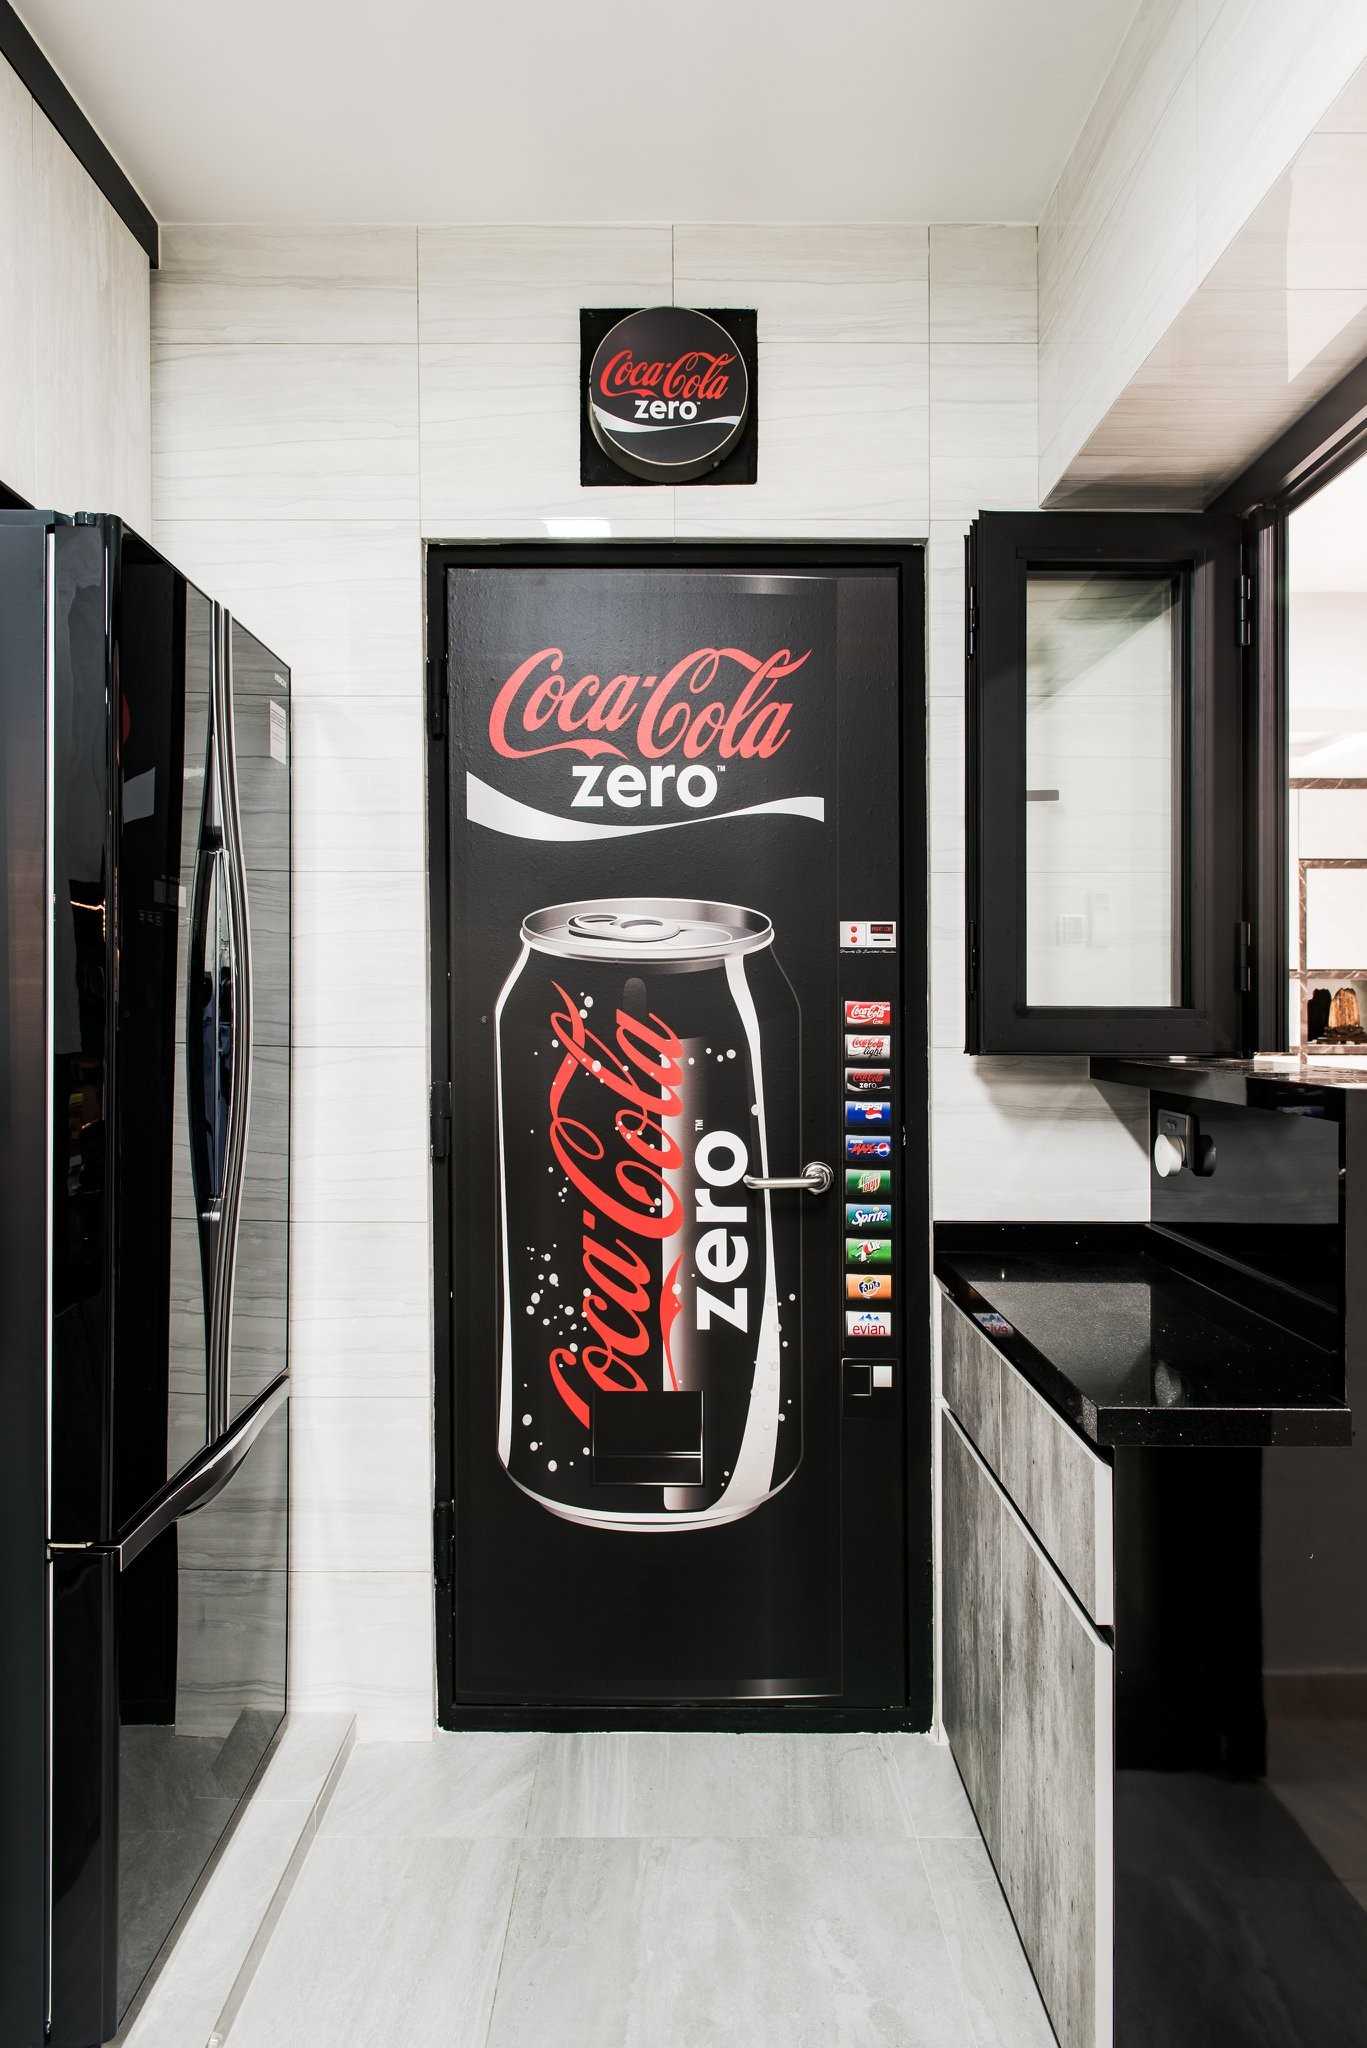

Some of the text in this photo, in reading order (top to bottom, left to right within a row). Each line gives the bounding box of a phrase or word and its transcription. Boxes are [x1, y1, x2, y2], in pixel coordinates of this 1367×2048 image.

[600, 350, 737, 400] Coca-Cola
[634, 400, 698, 420] zero
[488, 647, 813, 761] Coca-Cola
[570, 764, 718, 808] zero
[695, 1131, 749, 1334] zero
[852, 1209, 888, 1227] Sprite
[859, 1280, 881, 1293] Fanta
[852, 1323, 886, 1335] evian
